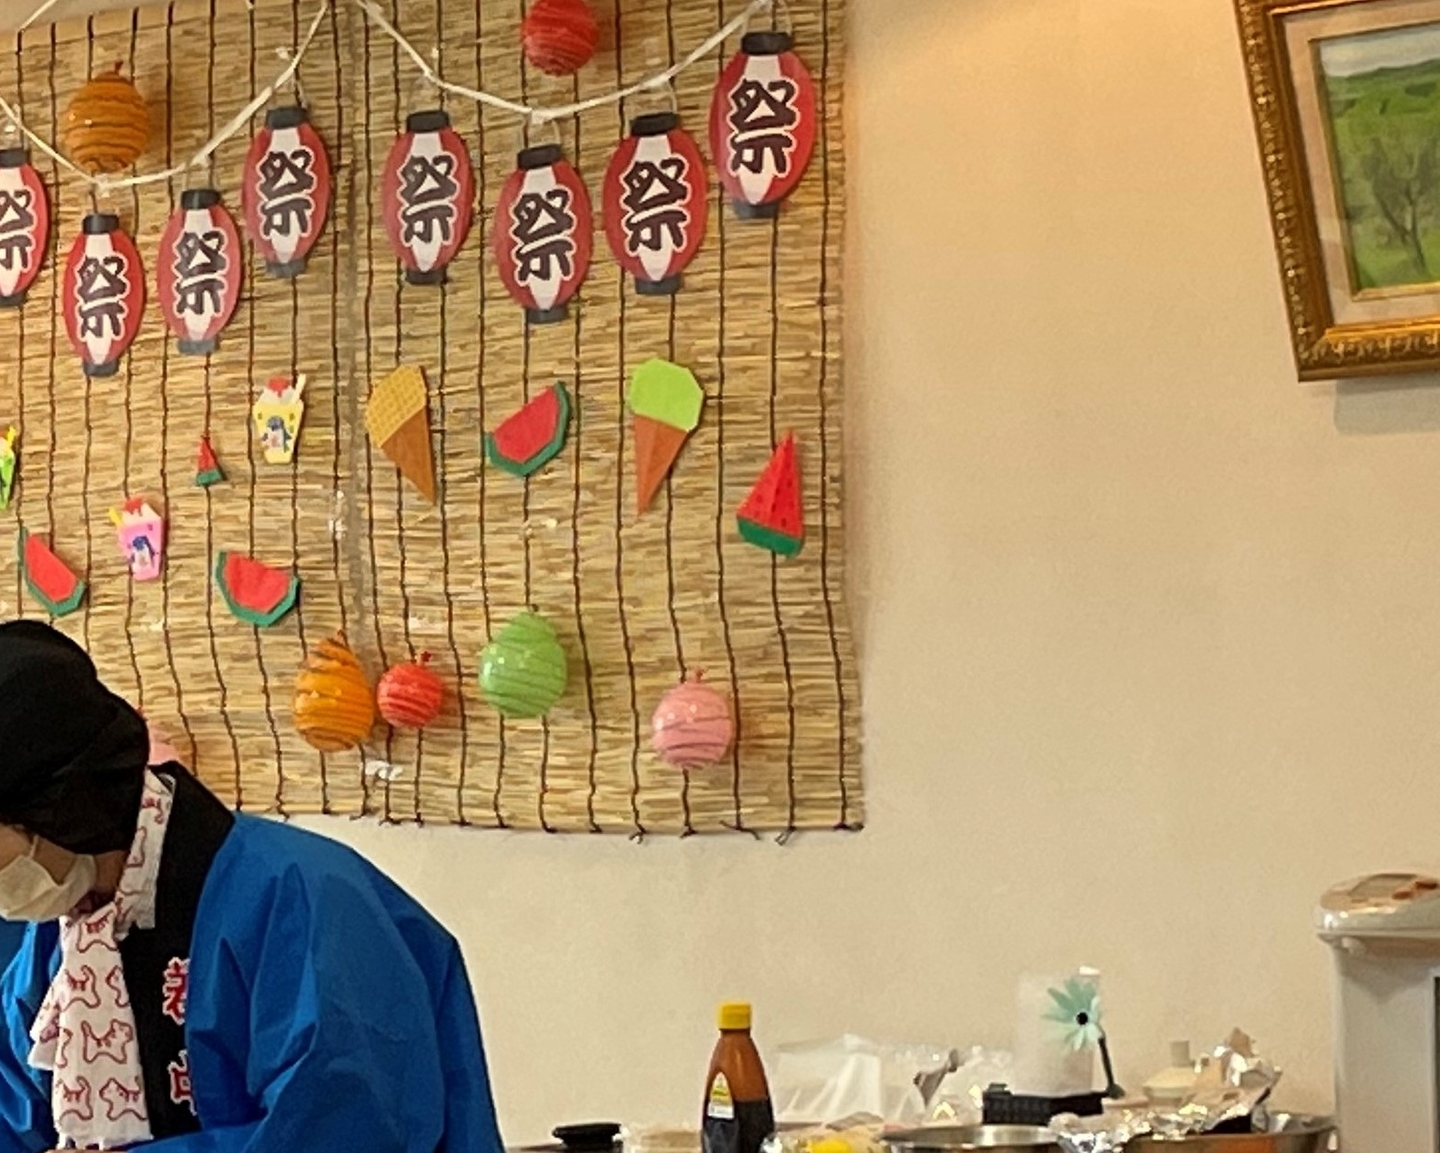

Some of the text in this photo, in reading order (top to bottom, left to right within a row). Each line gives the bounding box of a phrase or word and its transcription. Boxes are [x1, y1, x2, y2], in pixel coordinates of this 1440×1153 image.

[729, 77, 799, 176] 祭
[257, 148, 315, 238] 祭
[397, 151, 459, 245] 祭
[511, 185, 576, 283] 祭
[620, 153, 689, 253] 祭
[75, 253, 129, 339] 祭
[173, 228, 229, 316] 祭
